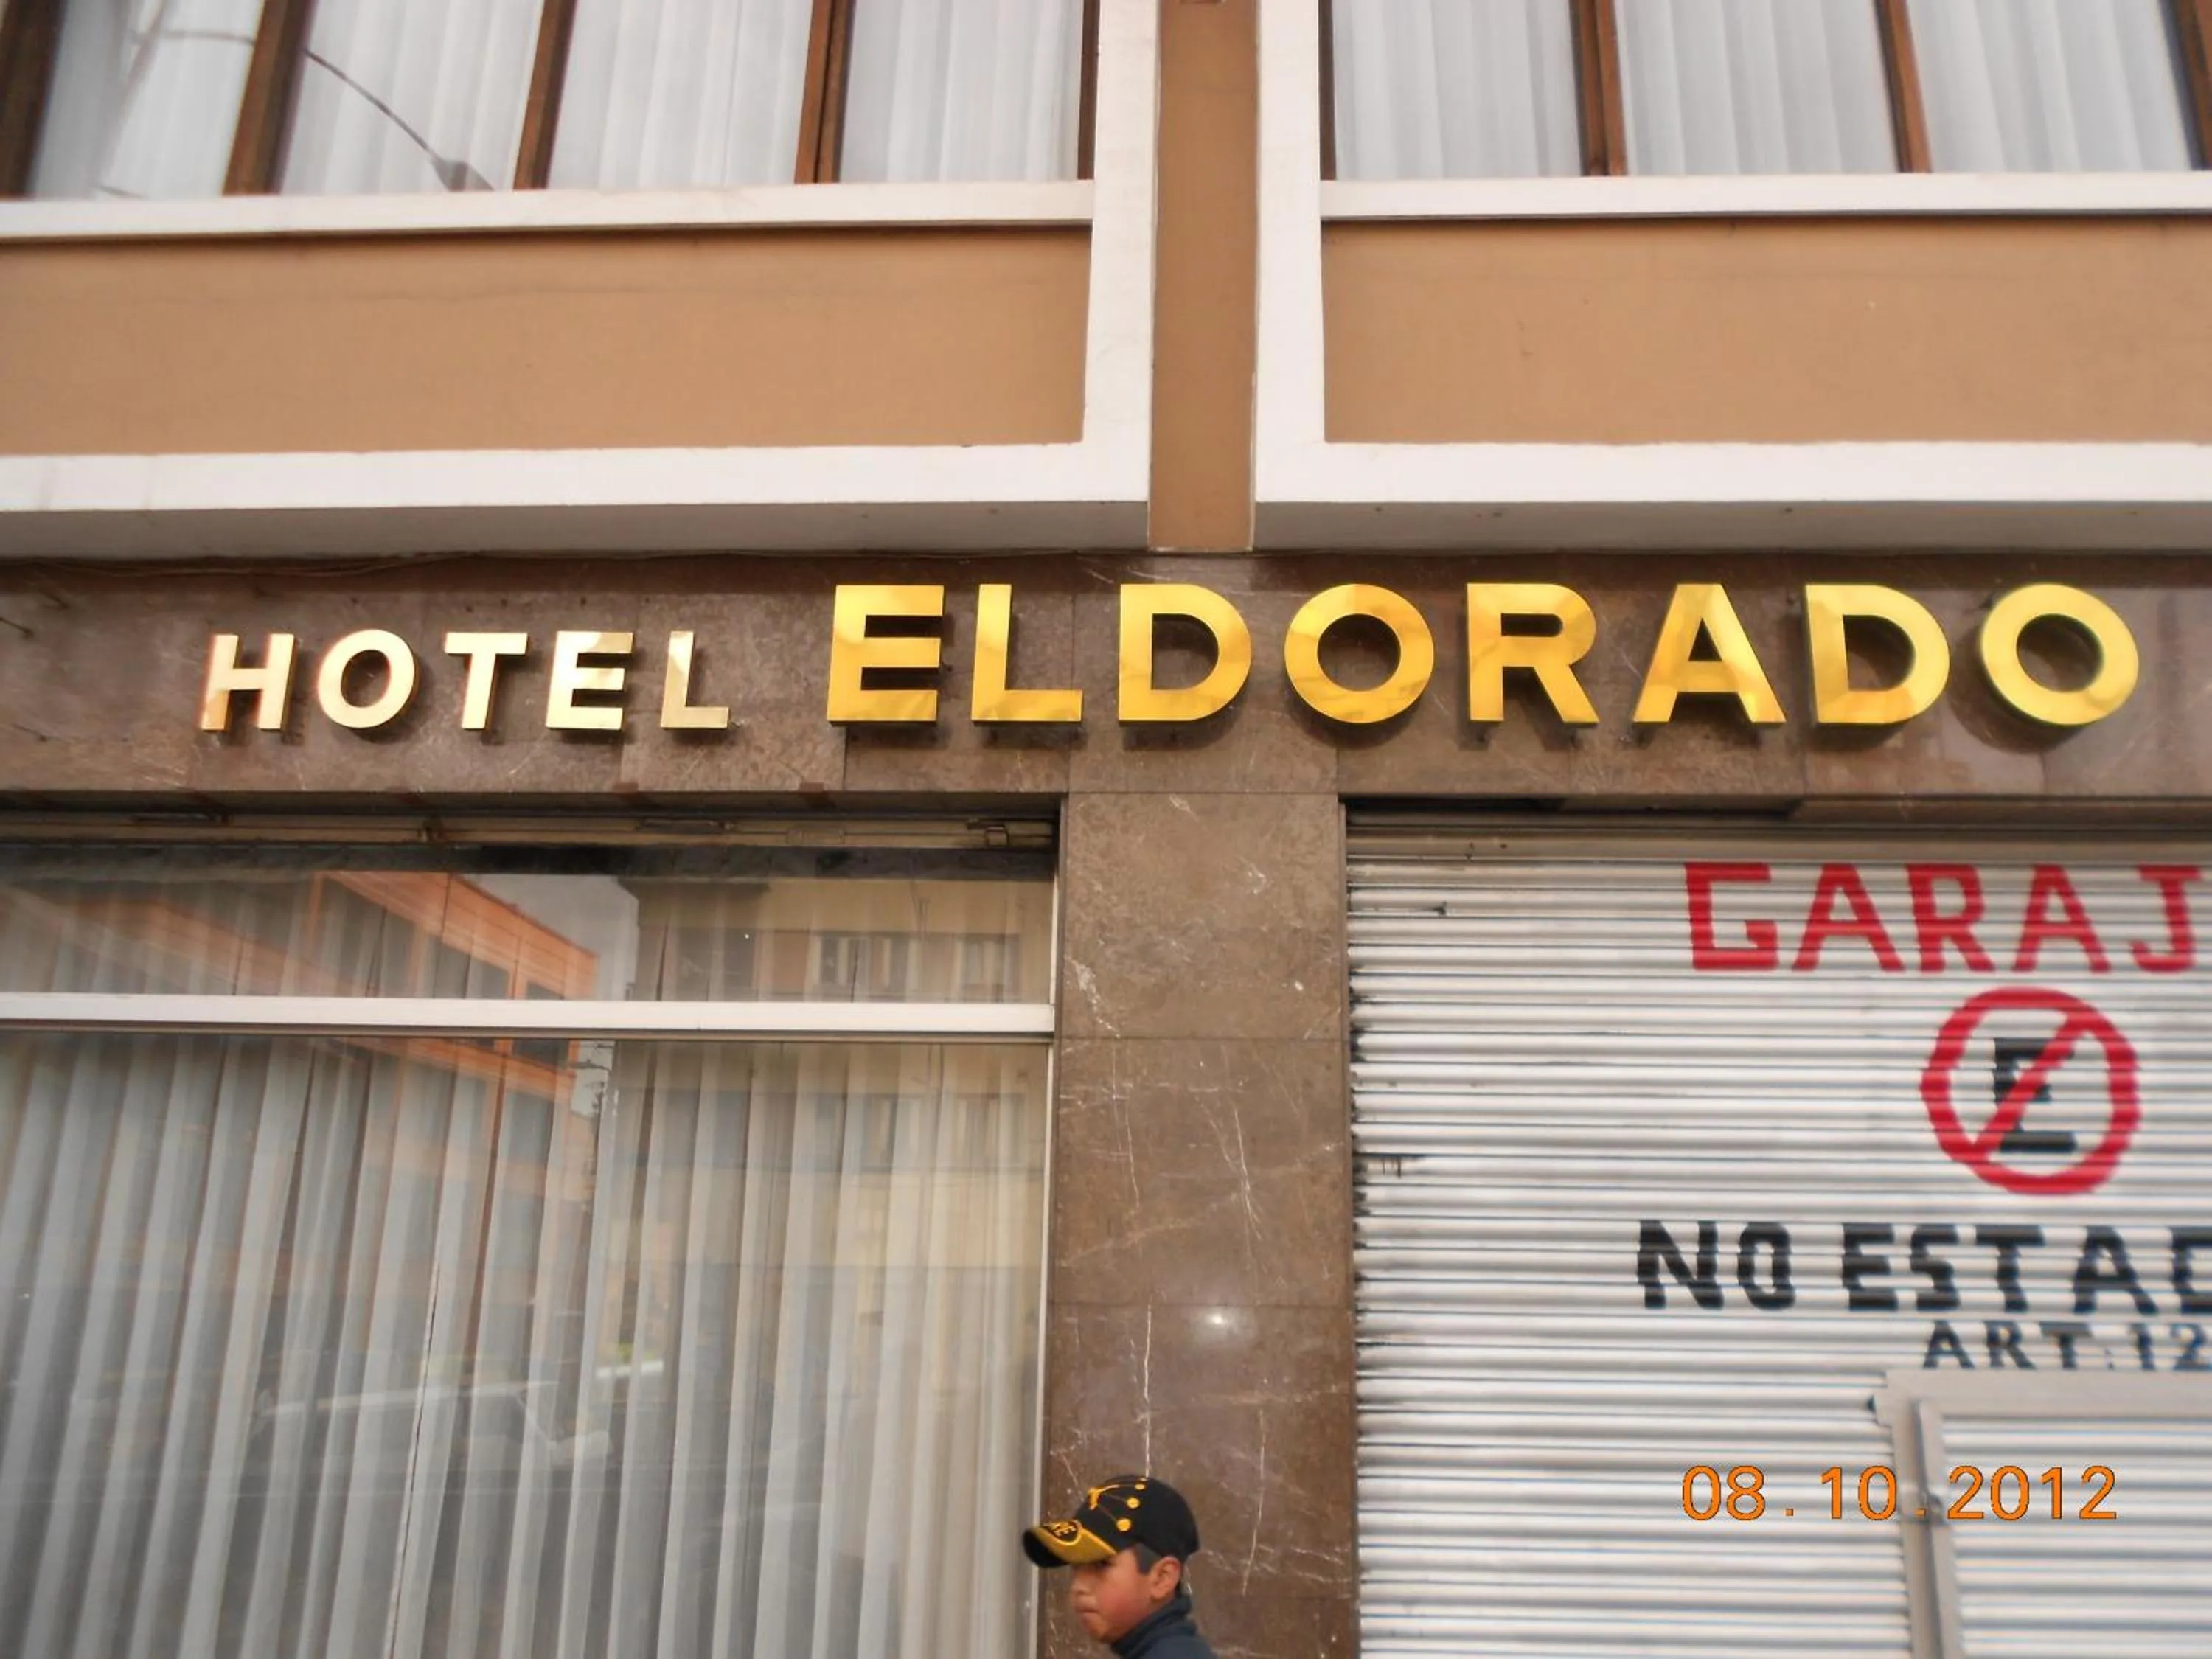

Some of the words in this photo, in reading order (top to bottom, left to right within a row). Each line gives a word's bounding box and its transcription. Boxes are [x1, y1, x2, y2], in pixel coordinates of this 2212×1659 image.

[201, 628, 730, 731] HOTEL
[1685, 862, 2203, 974] GARAJ
[1637, 1220, 1796, 1311] NO
